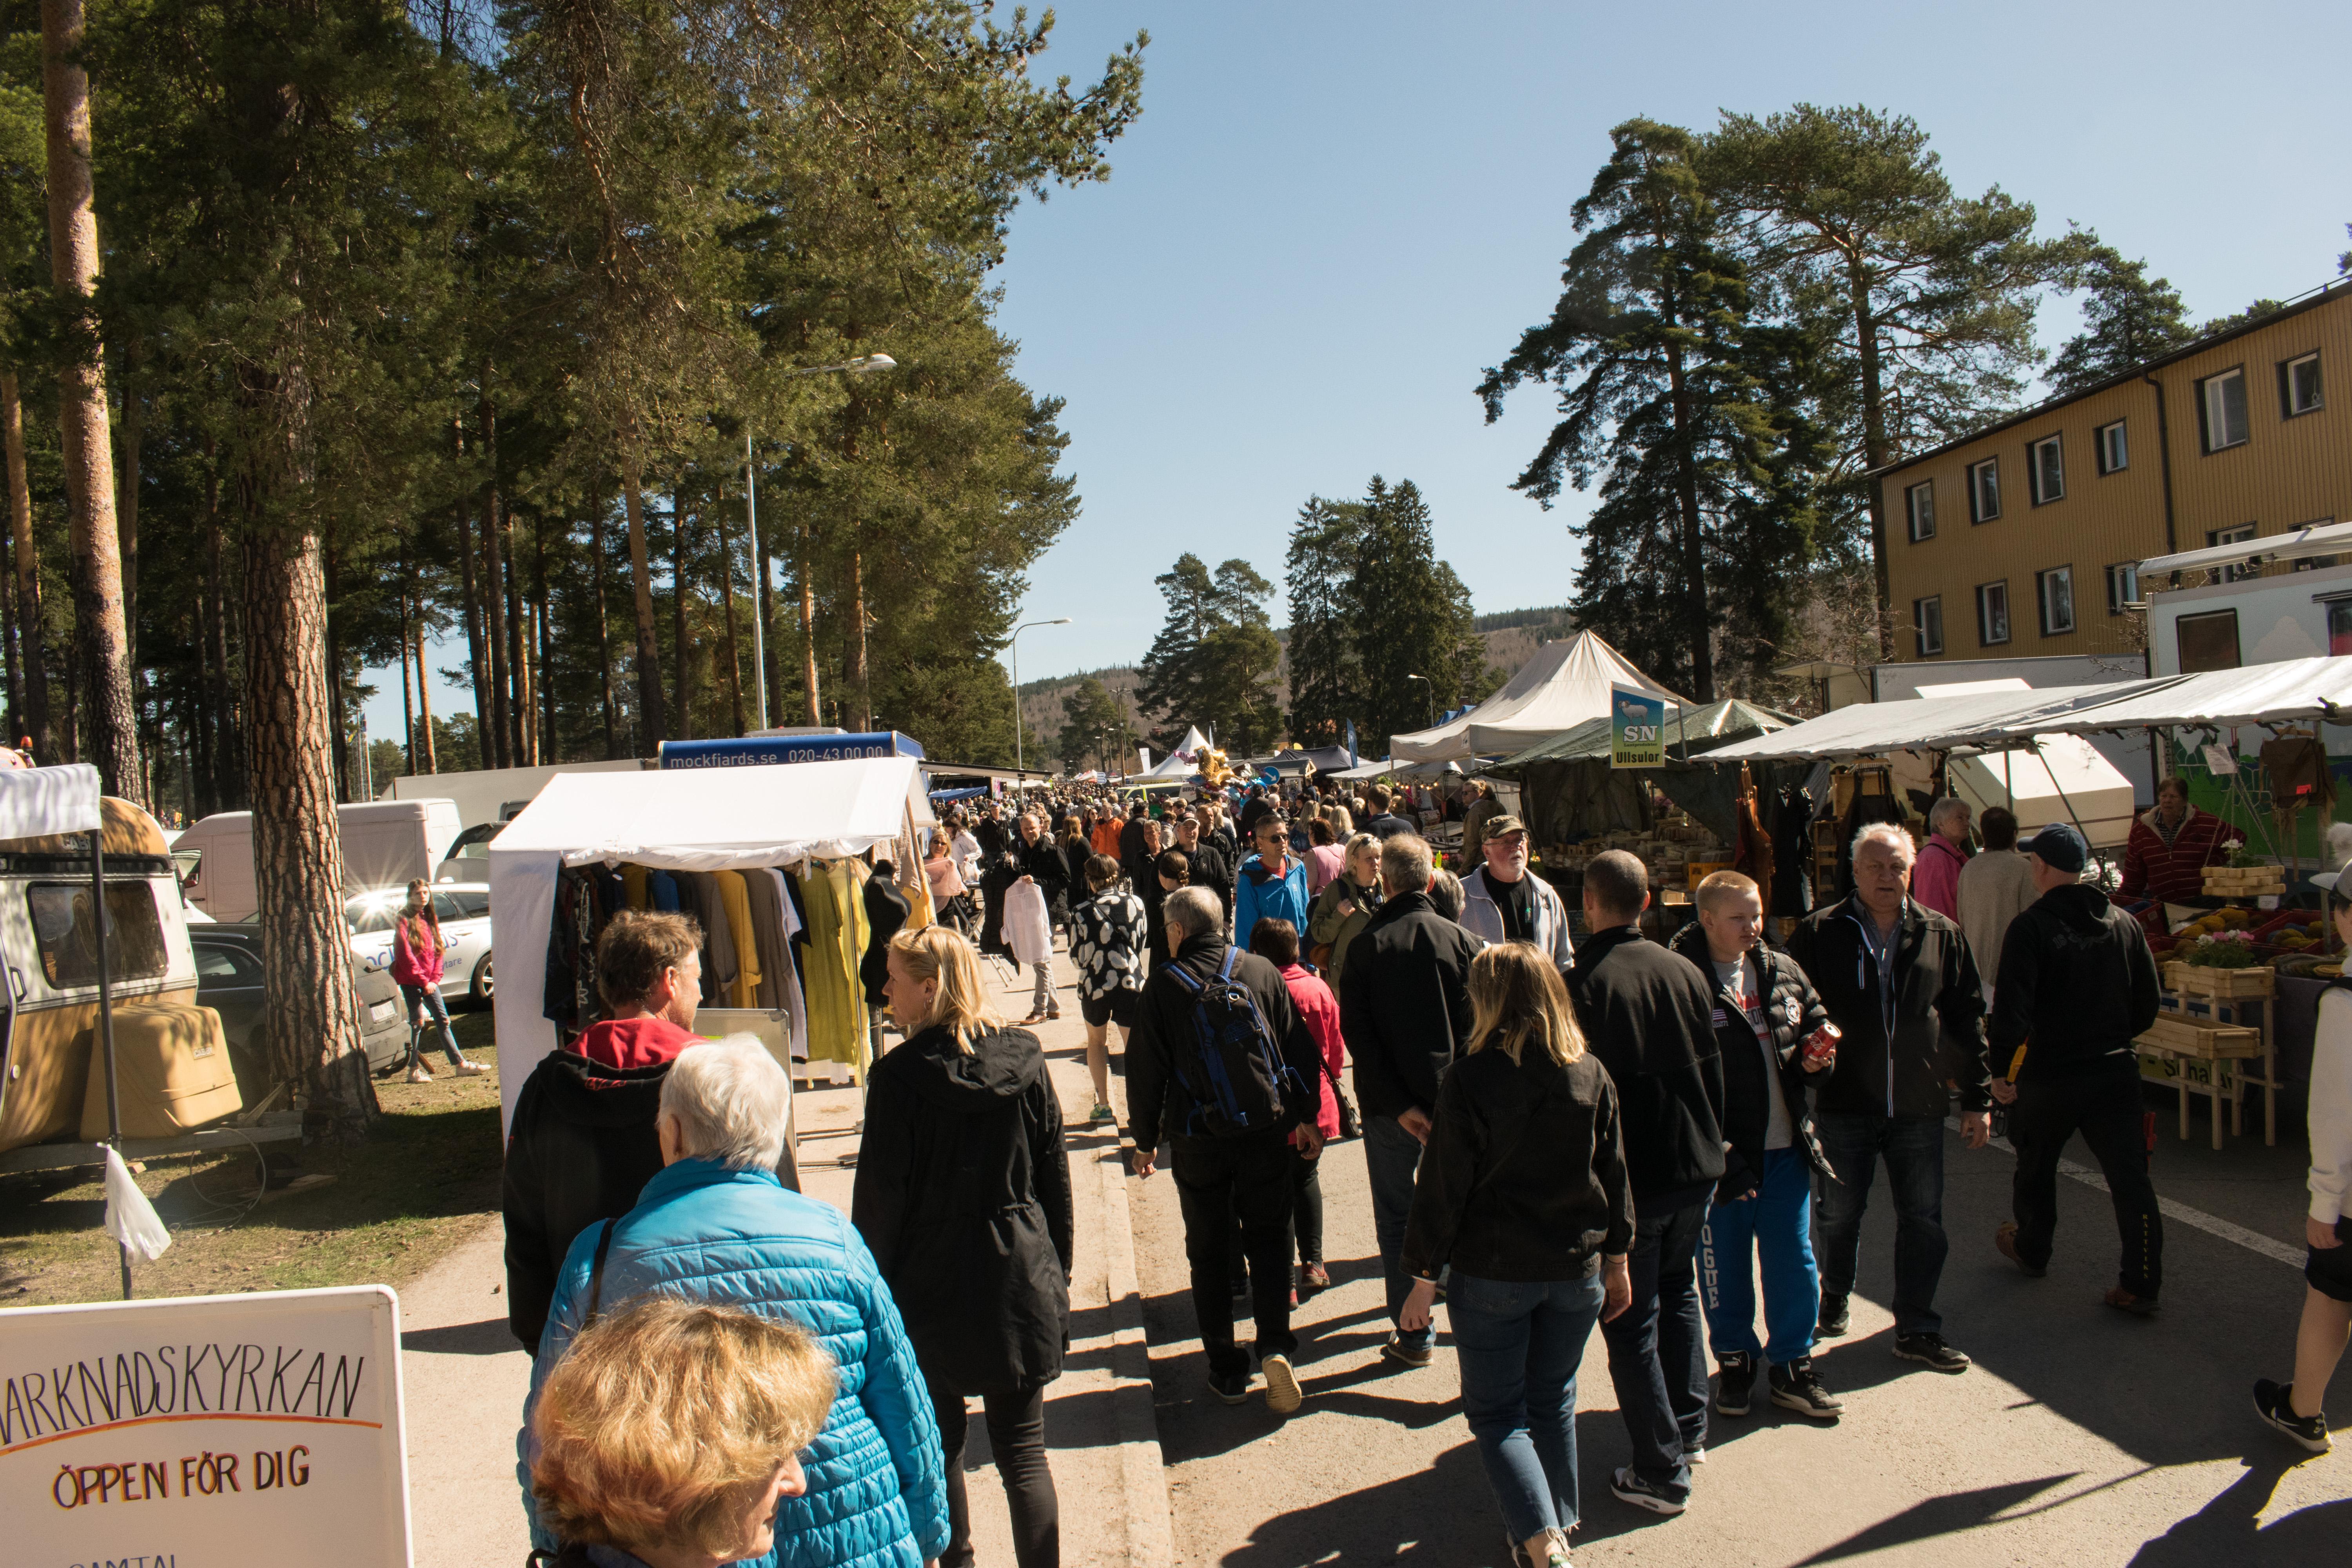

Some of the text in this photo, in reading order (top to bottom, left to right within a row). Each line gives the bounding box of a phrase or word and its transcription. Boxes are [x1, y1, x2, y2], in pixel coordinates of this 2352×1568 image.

[1623, 725, 1657, 742] SN
[789, 748, 840, 763] 020-43
[844, 747, 861, 759] 00
[867, 746, 884, 758] 00
[1617, 751, 1660, 763] Ullsulor
[53, 1445, 310, 1510] ÖPPEN FÖR DIG
